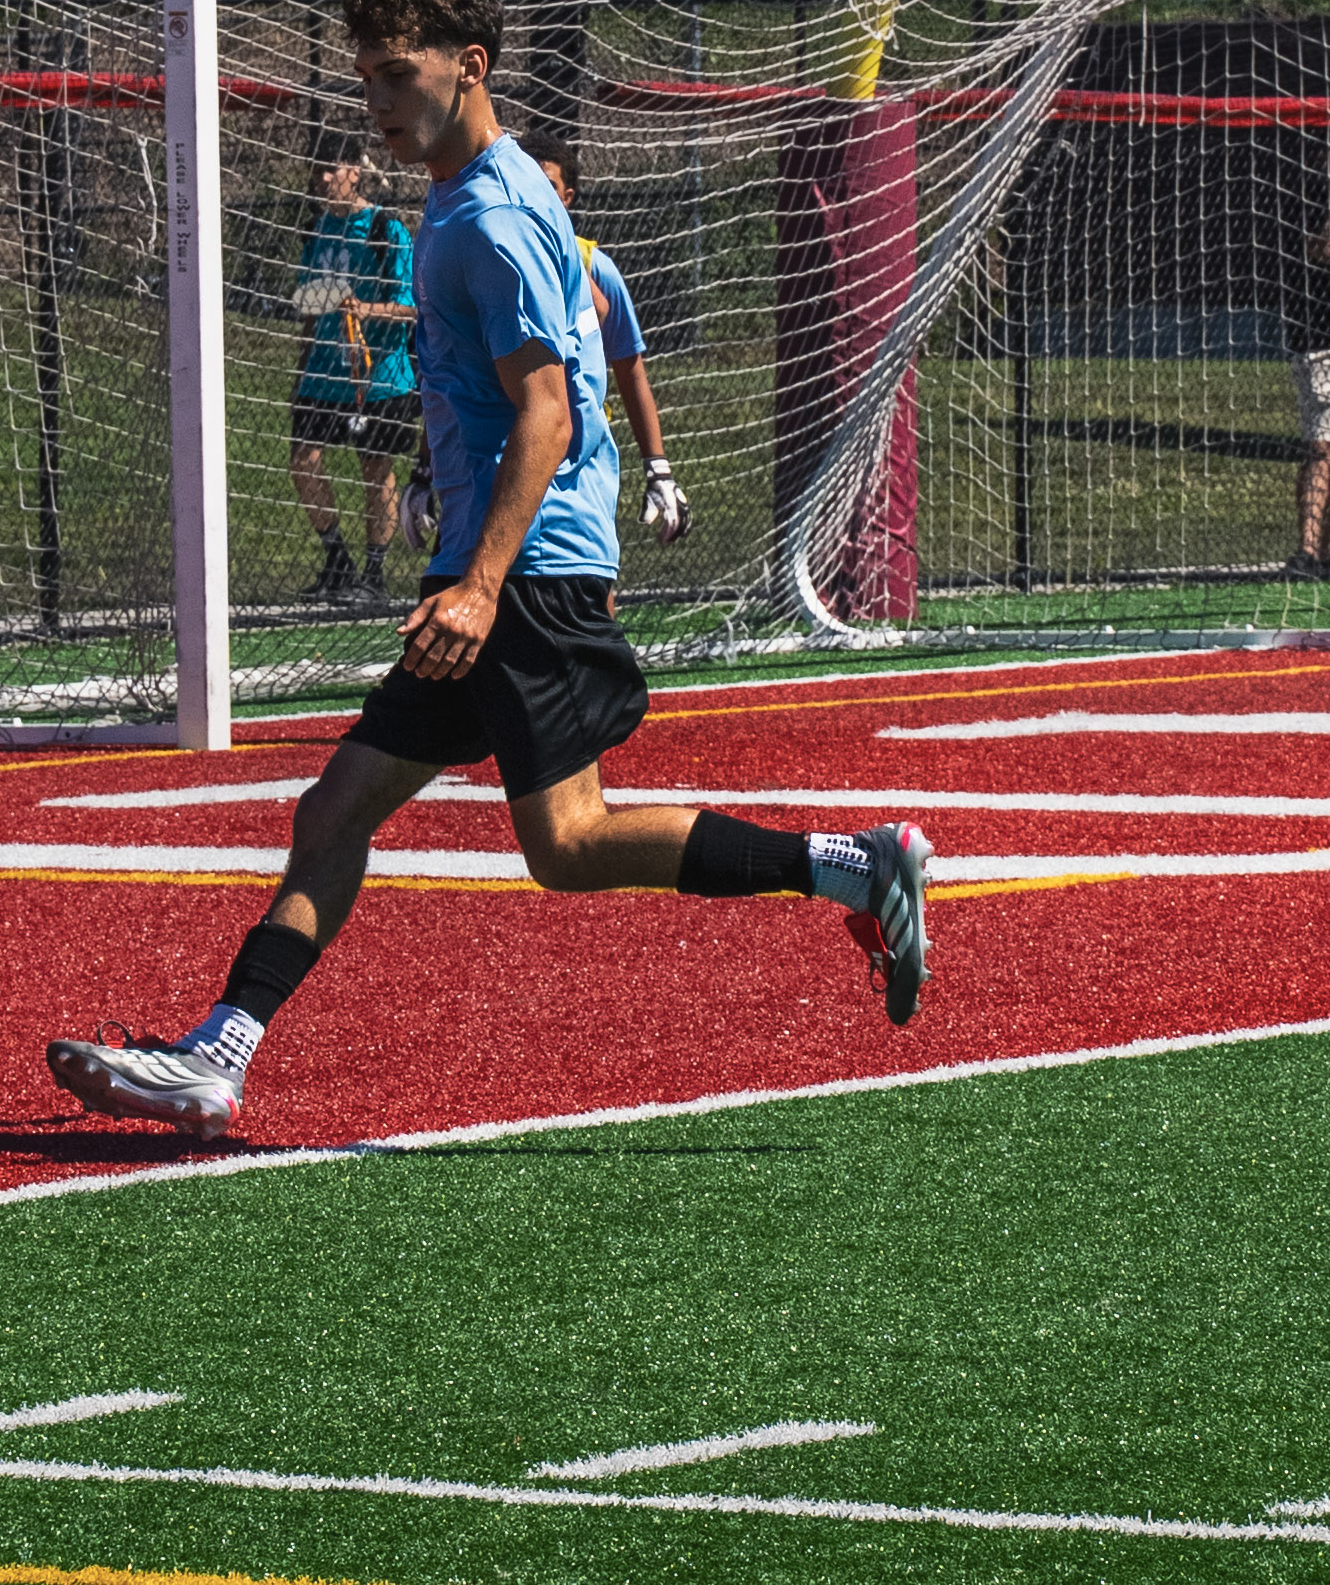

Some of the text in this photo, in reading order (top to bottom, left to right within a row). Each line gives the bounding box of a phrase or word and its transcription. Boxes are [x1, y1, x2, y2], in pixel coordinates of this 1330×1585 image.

[175, 142, 191, 273] PLEASE LOWER WHEELS
